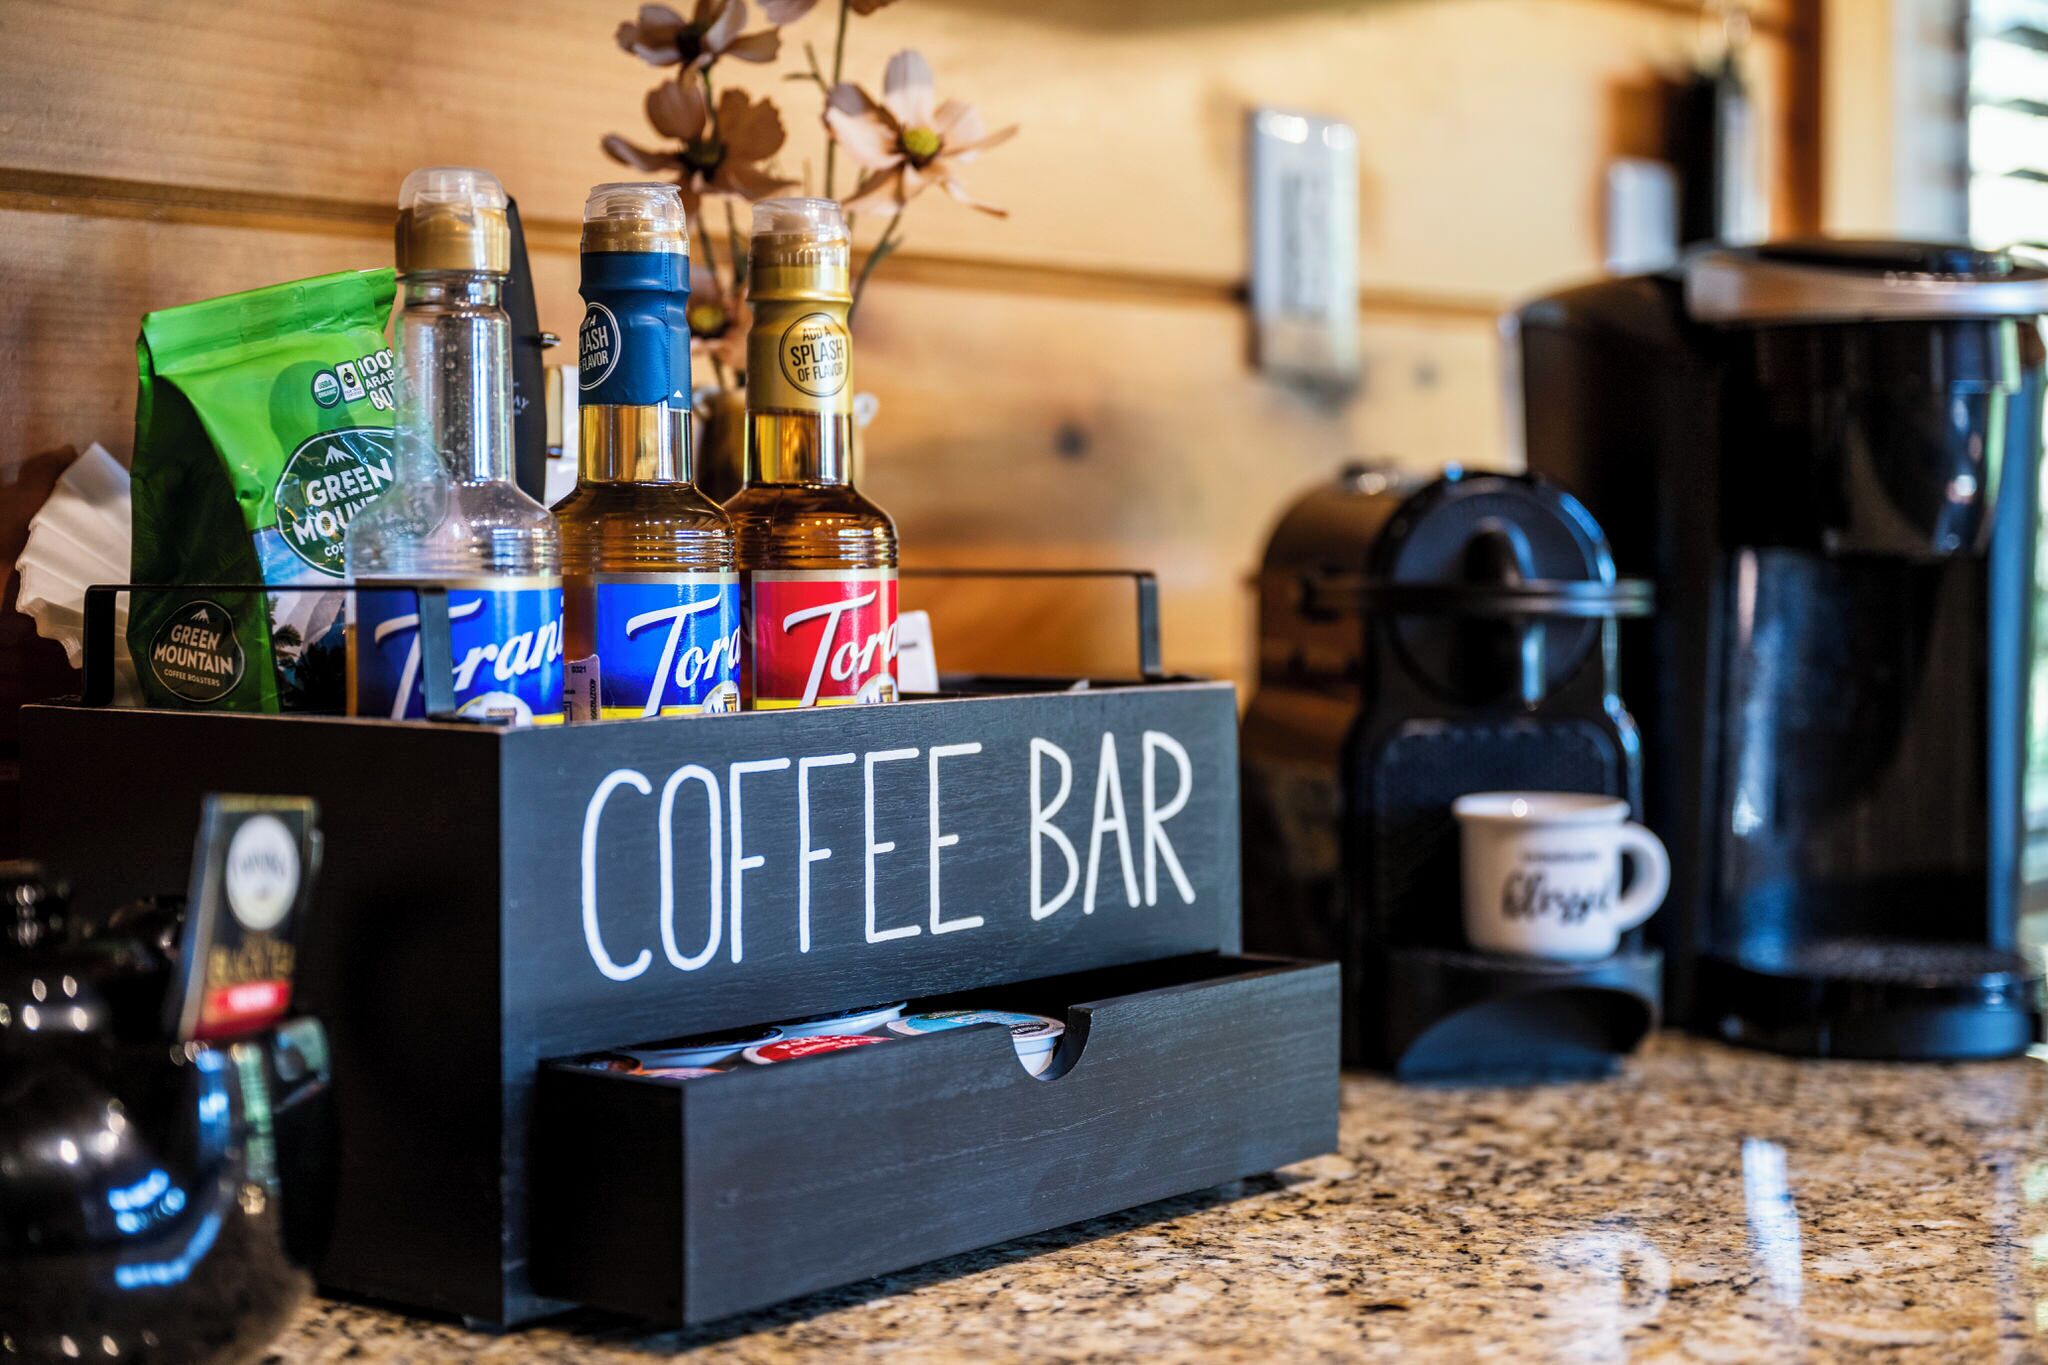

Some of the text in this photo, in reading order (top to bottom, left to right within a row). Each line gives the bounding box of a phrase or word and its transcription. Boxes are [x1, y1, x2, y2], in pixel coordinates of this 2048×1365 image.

[579, 326, 609, 355] LASH
[802, 325, 832, 342] ADD A
[582, 350, 609, 372] FLAVOR
[790, 338, 844, 367] SPLASH
[797, 362, 843, 382] OF FLAVOR
[306, 457, 393, 507] GREEN
[171, 624, 221, 651] GREEN
[154, 642, 234, 675] MOUNTAIN
[164, 668, 221, 687] COFFEE ROASTERS
[581, 730, 1197, 983] COFFEE BAR
